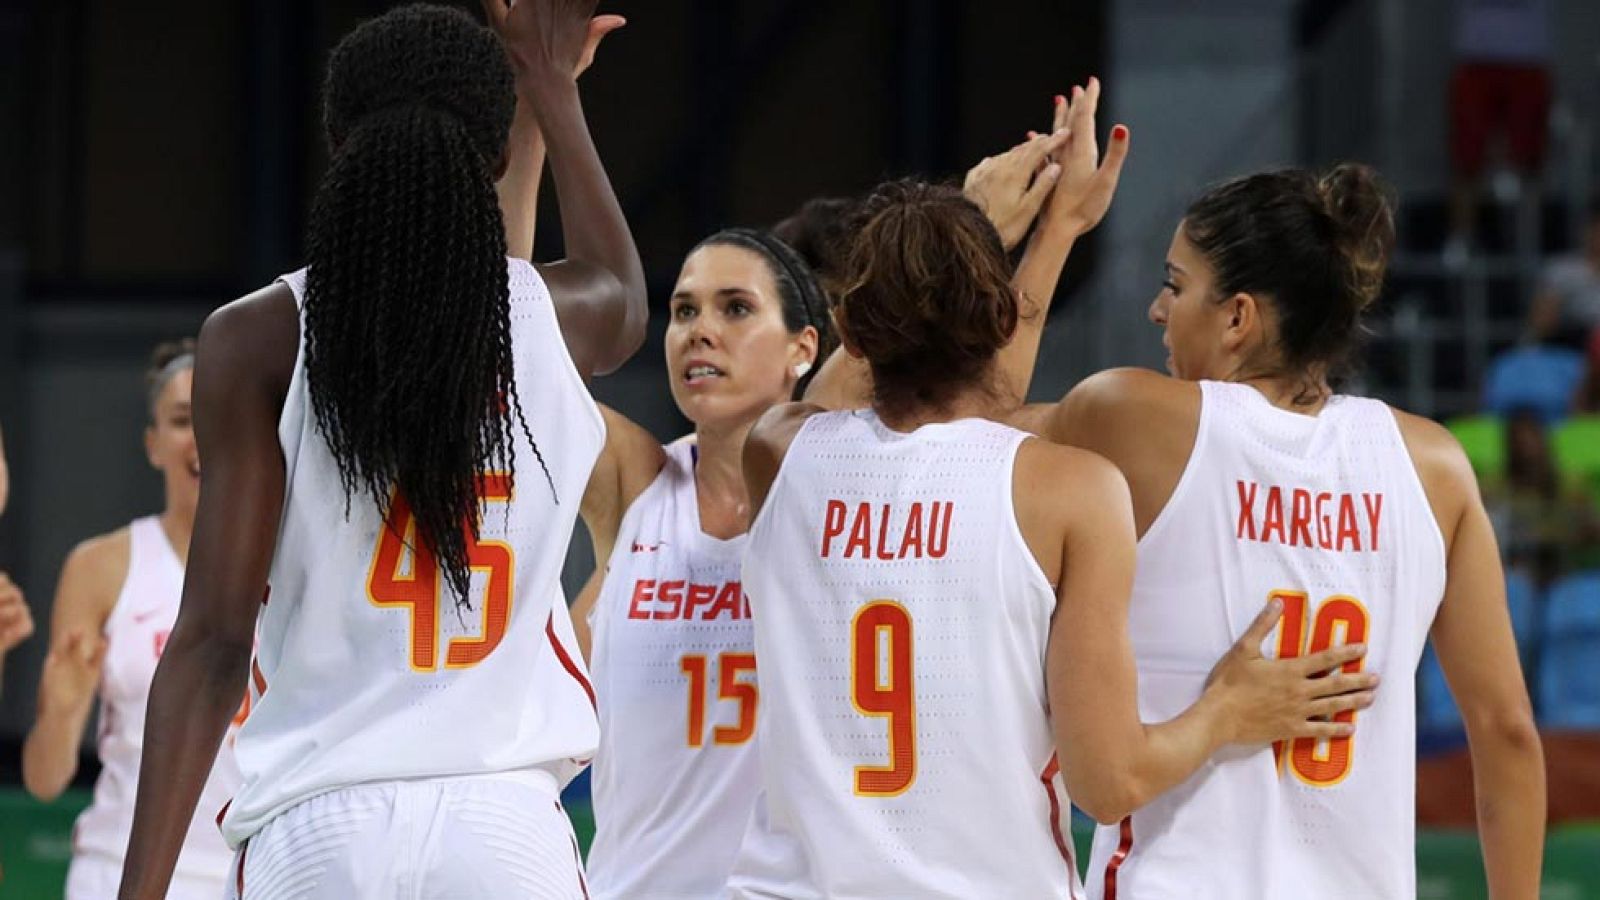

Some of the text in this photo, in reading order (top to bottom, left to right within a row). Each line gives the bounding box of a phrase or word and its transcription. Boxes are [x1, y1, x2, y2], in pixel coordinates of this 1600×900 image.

[820, 499, 954, 561] PALAU
[1236, 480, 1384, 553] XARGAY
[366, 470, 516, 672] 45
[628, 579, 752, 620] ESPA
[679, 652, 759, 748] 15
[850, 600, 916, 797] 9
